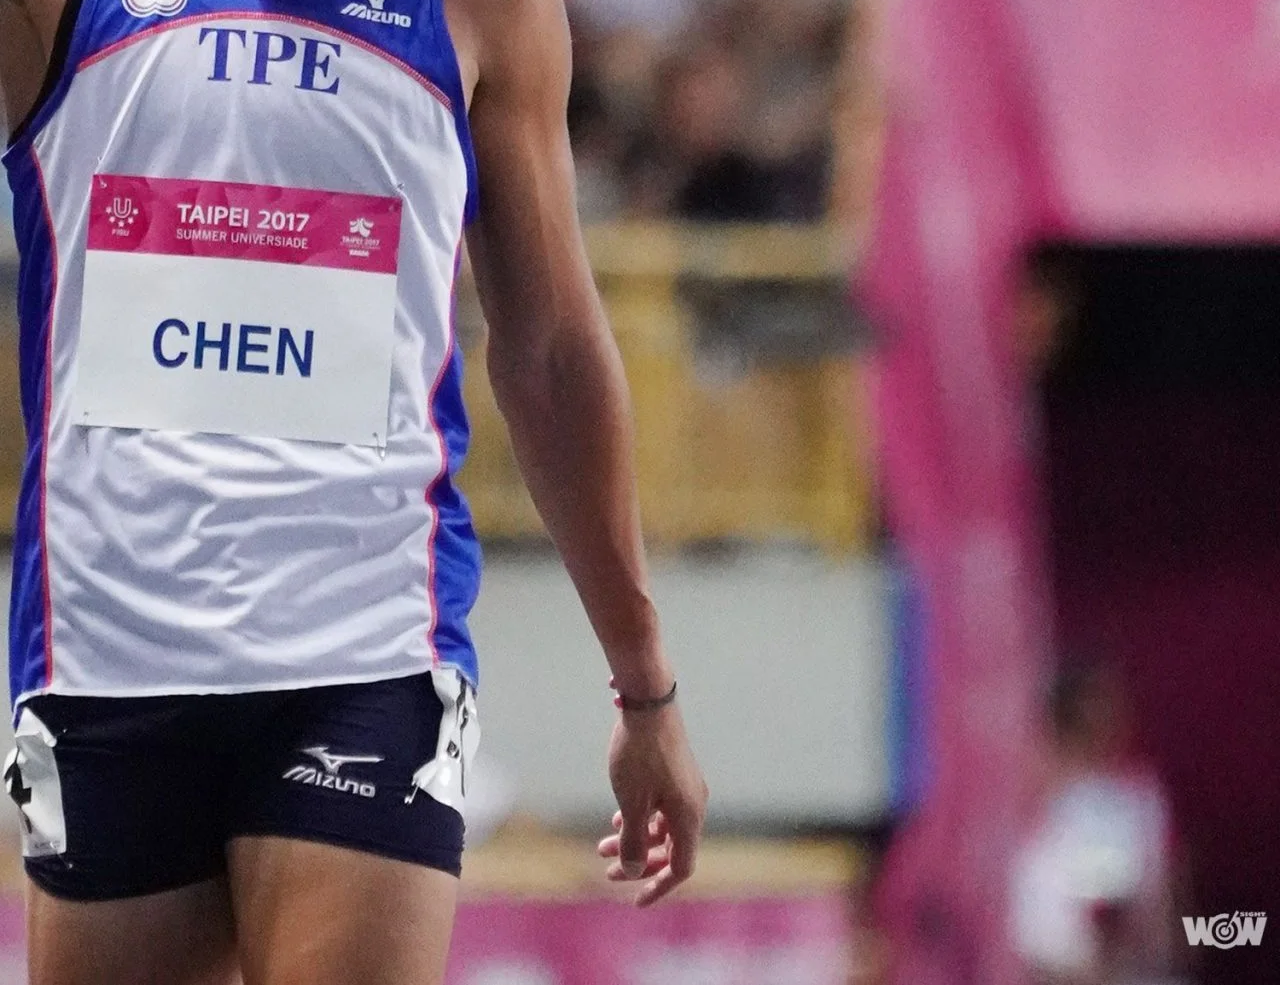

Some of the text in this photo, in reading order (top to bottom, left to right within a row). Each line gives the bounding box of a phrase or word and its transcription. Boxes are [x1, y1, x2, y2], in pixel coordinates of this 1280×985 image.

[340, 2, 412, 28] MIZUNO
[198, 27, 342, 96] TPE
[176, 203, 310, 232] TAIPEI 2017
[176, 228, 309, 250] SUMMER UNIVERSIADE
[152, 318, 315, 378] CHEN
[283, 765, 376, 798] MIZUNO
